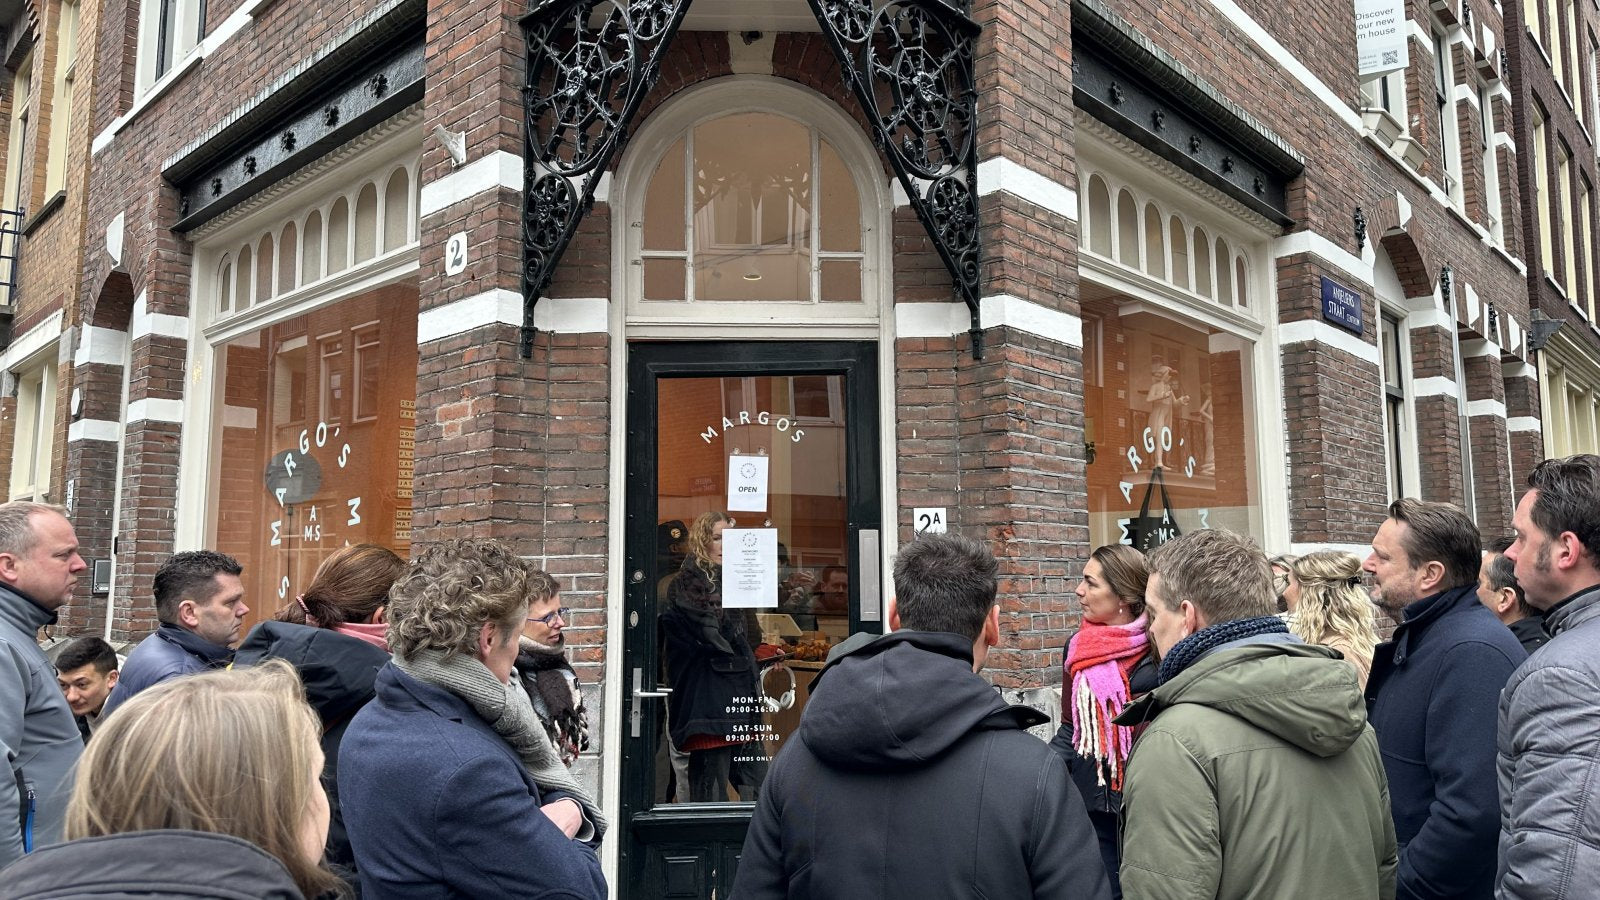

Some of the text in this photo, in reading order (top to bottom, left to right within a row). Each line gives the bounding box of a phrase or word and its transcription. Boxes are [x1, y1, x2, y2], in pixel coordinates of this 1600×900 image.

[1355, 9, 1394, 20] Discover
[1375, 18, 1395, 27] new
[1368, 27, 1396, 38] house
[450, 239, 464, 269] 2
[1328, 300, 1346, 320] STRAAT
[700, 410, 805, 444] MARGO'S
[270, 421, 351, 547] MARGO'S
[1117, 426, 1196, 546] MARGO'S
[732, 696, 773, 704] MON-FRI
[732, 724, 773, 732] SAT-SUN
[725, 734, 780, 742] 09:00-17:00
